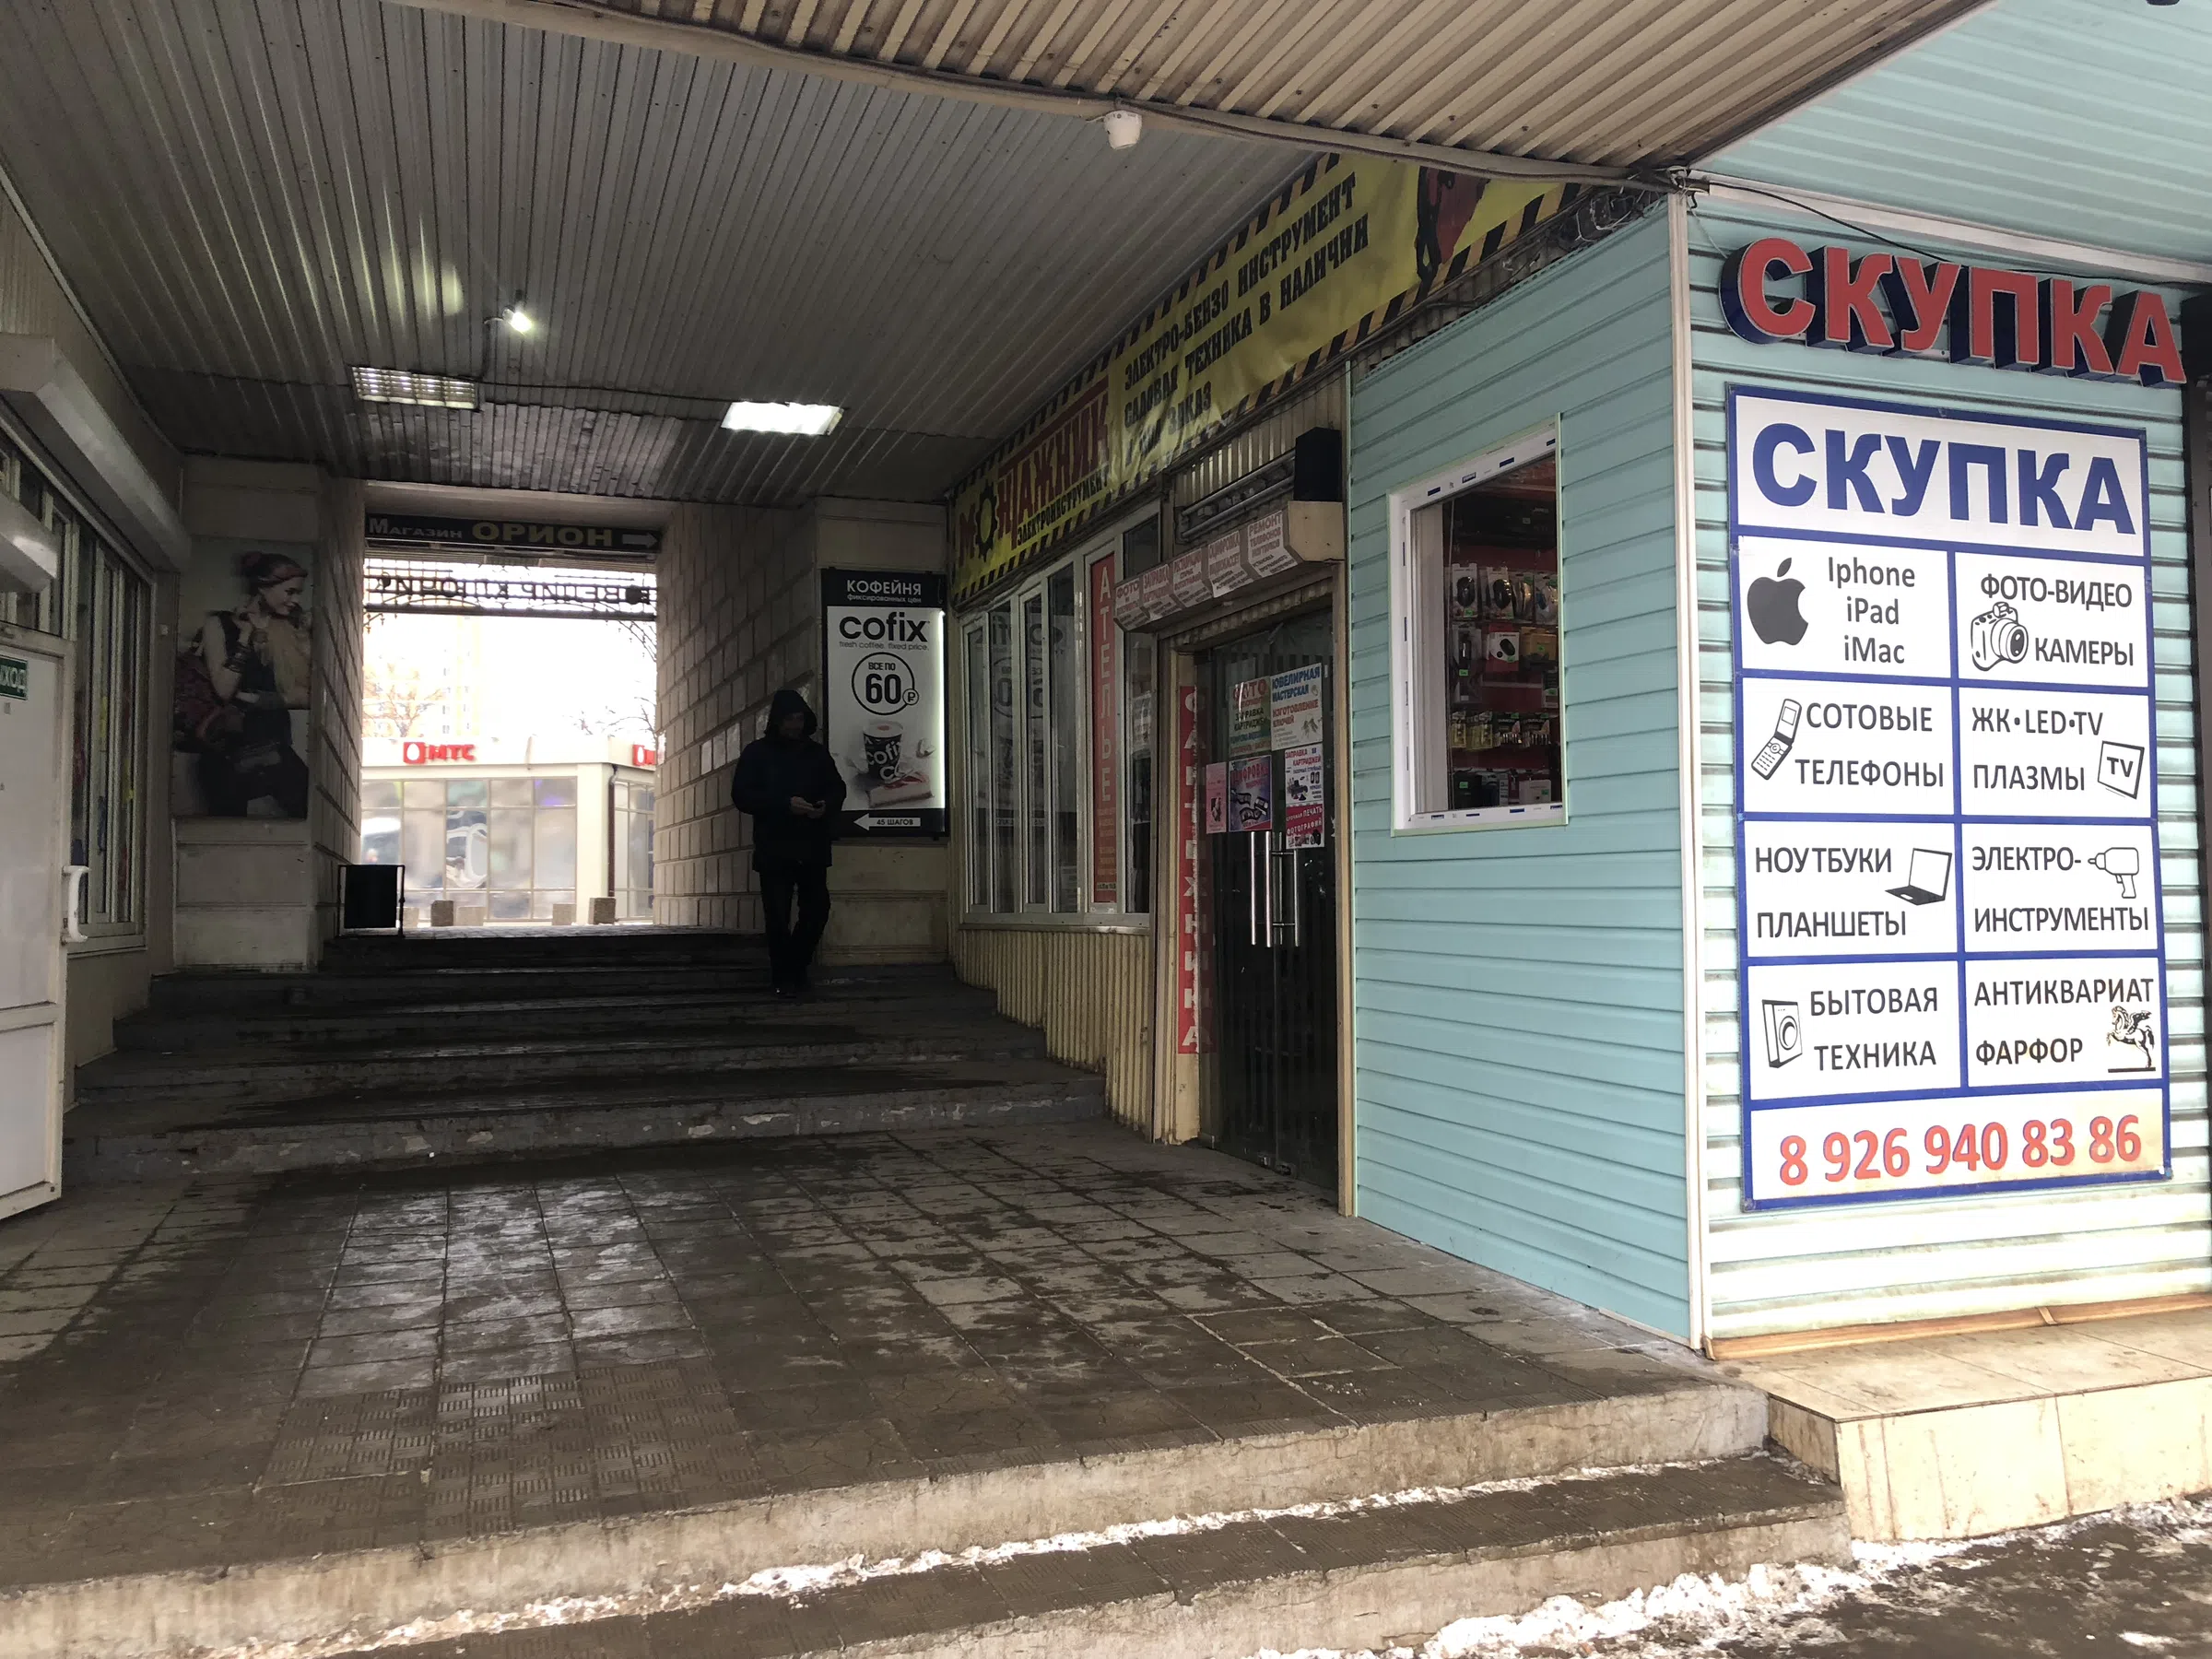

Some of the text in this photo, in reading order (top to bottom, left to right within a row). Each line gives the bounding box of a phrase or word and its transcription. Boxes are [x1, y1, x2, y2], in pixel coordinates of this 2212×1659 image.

[1238, 176, 1357, 299] ИНСТРУМЕНТ
[1184, 306, 1253, 382] ТЕХНИКА
[1259, 290, 1271, 326] В
[1280, 212, 1370, 311] НАЛИЧИИ
[1736, 236, 2187, 384] СКУПКА
[1752, 422, 2136, 535] СКУПКА
[472, 522, 613, 547] ОРИОН
[1249, 512, 1281, 537] РЕМОНТ
[846, 579, 922, 596] КОФЕЙНЯ
[1828, 557, 1916, 590] Iphone
[1117, 580, 1139, 599] ФОТО
[1980, 572, 2133, 612] ФОТО-ВИДЕО
[1845, 596, 1900, 626] iPad
[839, 611, 928, 642] cofix
[1843, 634, 1906, 664] iMac
[2034, 636, 2135, 667] КАМЕРЫ
[884, 662, 896, 671] ПО
[1272, 665, 1321, 689] ЮВЕЛИРНАЯ
[865, 673, 902, 705] 60
[1100, 565, 1113, 802] АТЕЛЬЕ
[1272, 684, 1309, 703] МАСТЕРСКАЯ
[1272, 699, 1319, 718] ИЗГОТОВЛЕНИЕ
[1806, 701, 1934, 733] СОТОВЫЕ
[428, 744, 476, 761] МТС
[1794, 759, 1944, 788] ТЕЛЕФОНЫ
[1973, 764, 2086, 792] ПЛАЗМЫ
[2106, 757, 2134, 778] TV
[1303, 806, 1323, 817] ПЕЧАТЬ
[1755, 846, 1892, 874] НОУТБУКИ
[1971, 845, 2082, 872] ЭЛЕКТРО-
[1757, 911, 1907, 938] ПЛАНШЕТЫ
[1973, 907, 2149, 934] ИНСТРУМЕНТЫ
[1810, 986, 1938, 1017] БЫТОВАЯ
[1973, 977, 2154, 1006] АНТИКВАРИАТ
[1814, 1040, 1937, 1072] ТЕХНИКА
[1975, 1037, 2085, 1066] ФАРФОР
[1779, 1113, 2142, 1186] 8 926 940 83 86
